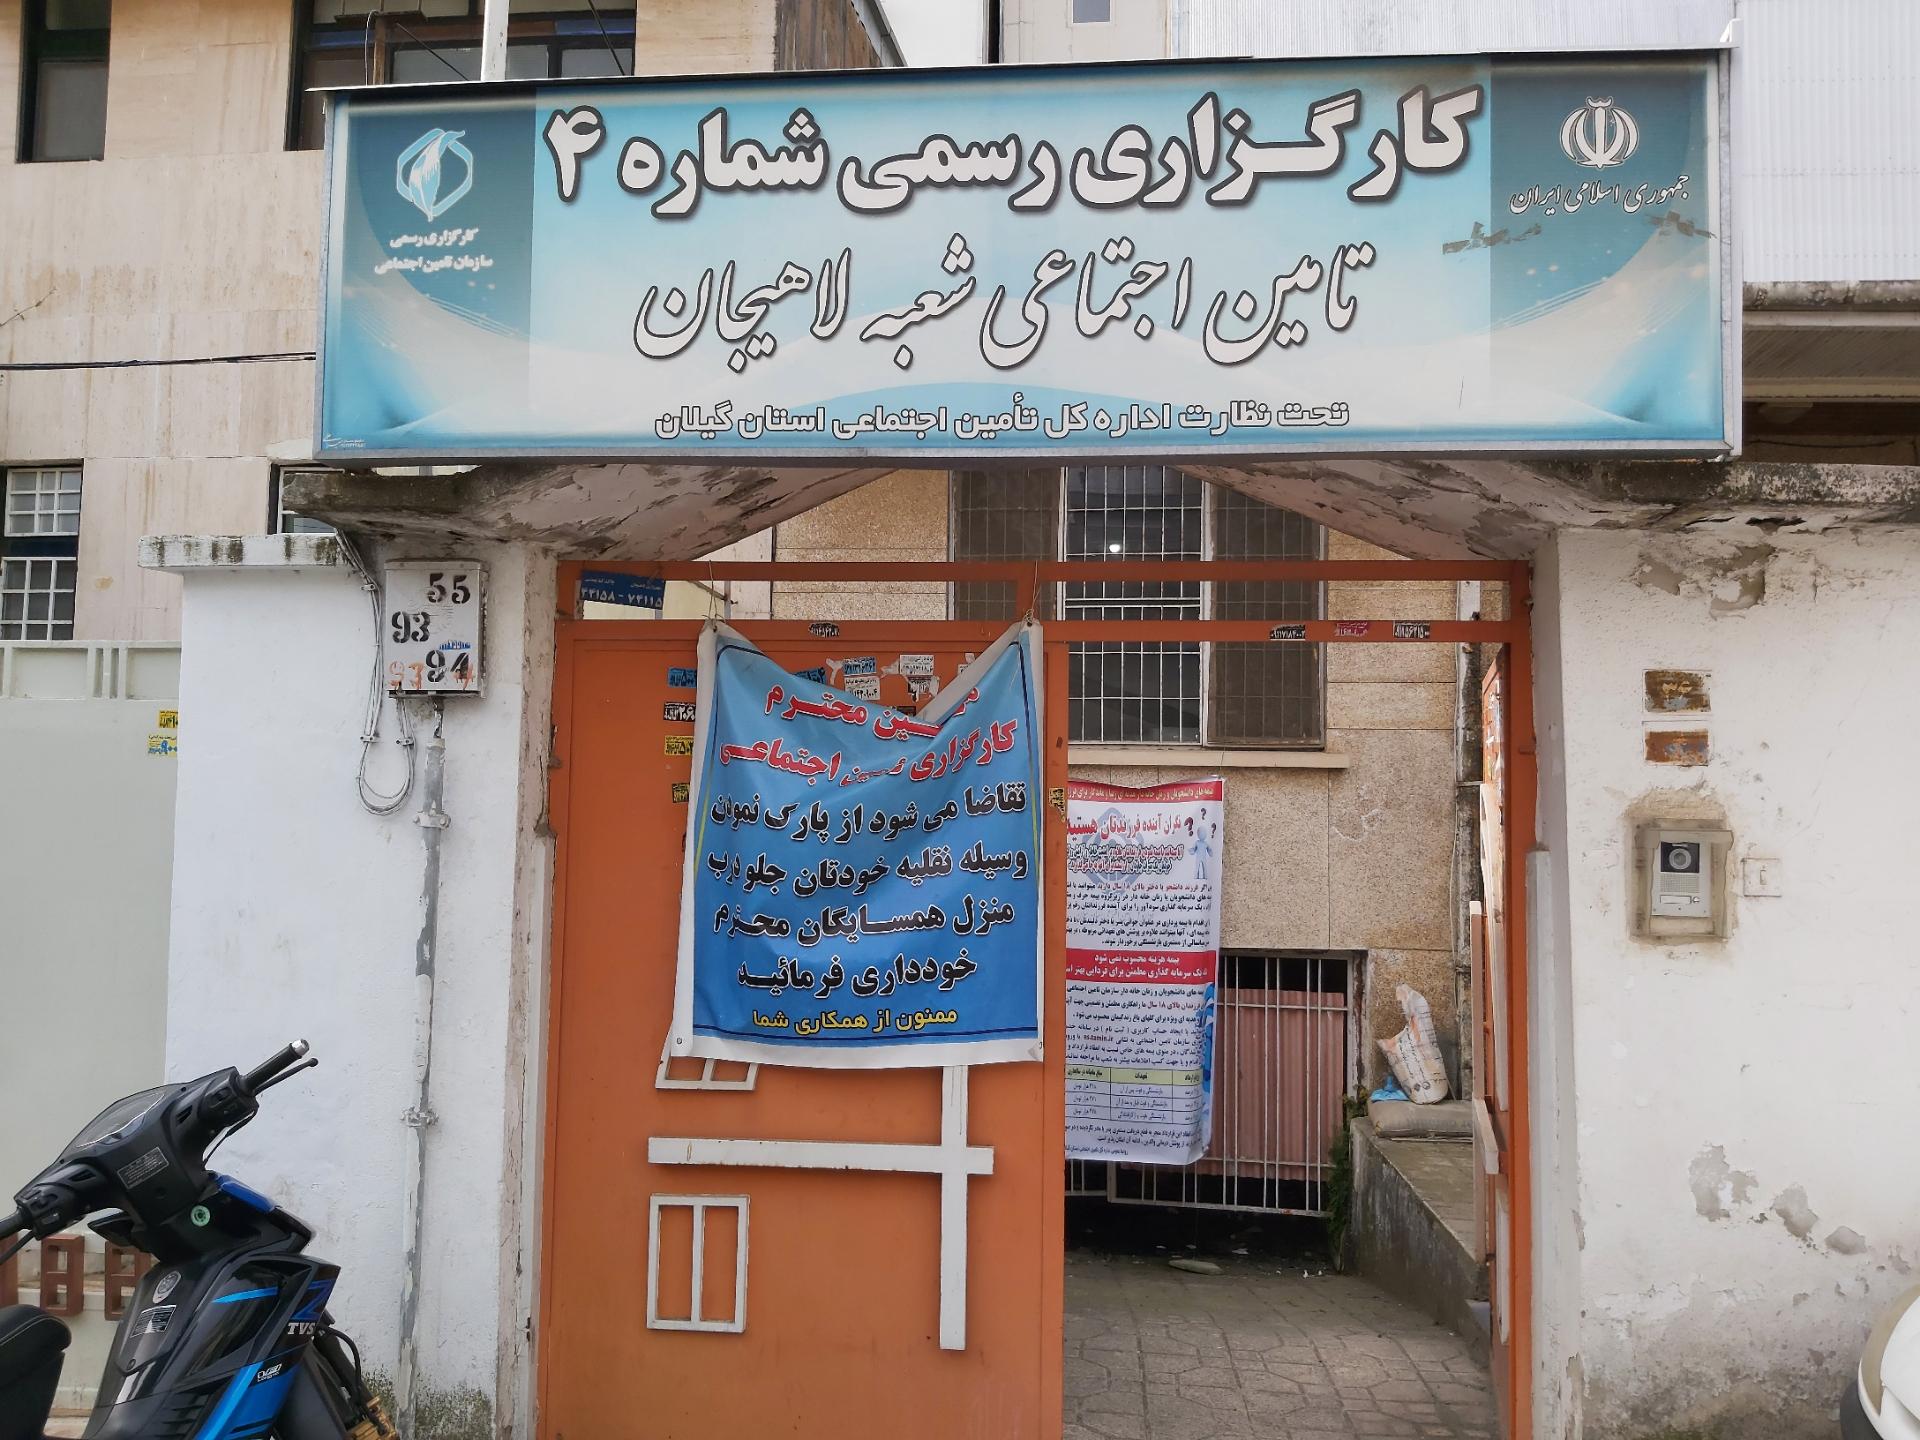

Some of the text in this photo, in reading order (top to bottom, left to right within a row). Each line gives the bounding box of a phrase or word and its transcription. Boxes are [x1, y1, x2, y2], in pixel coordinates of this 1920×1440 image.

[542, 104, 606, 202] ۴
[616, 107, 828, 220] شماره
[836, 128, 1062, 215] رسمی
[1509, 175, 1690, 216] جمهوری اسلامی ایران
[389, 233, 424, 249] رسمی
[374, 256, 423, 275] اجتماعی
[454, 254, 494, 273] سازمان
[632, 233, 1376, 375] تامین اجتماعی شعبه لاهیجان
[654, 391, 1350, 441] تحت نظارت اداره کل تأمین اجتماعی استان گیلان
[427, 572, 471, 604] 55
[391, 611, 431, 644] 93
[764, 682, 869, 726] محترم
[719, 736, 843, 787] اجتماعی
[908, 718, 1018, 782] کارگزاری
[921, 798, 959, 832] می
[963, 780, 1027, 815] تقاضا
[763, 800, 830, 844] پارک
[835, 806, 863, 844] از
[868, 803, 919, 841] شود
[743, 852, 787, 893] جلو
[792, 858, 890, 898] خودتان
[895, 845, 953, 888] نقلیه
[958, 841, 1029, 880] وسیله
[796, 902, 946, 947] همسایگان
[951, 894, 1015, 936] منزل
[736, 948, 978, 1000] خودداری فرمائید
[752, 1008, 959, 1037] ممنون از همکاری شما
[287, 1322, 316, 1335] TVS
